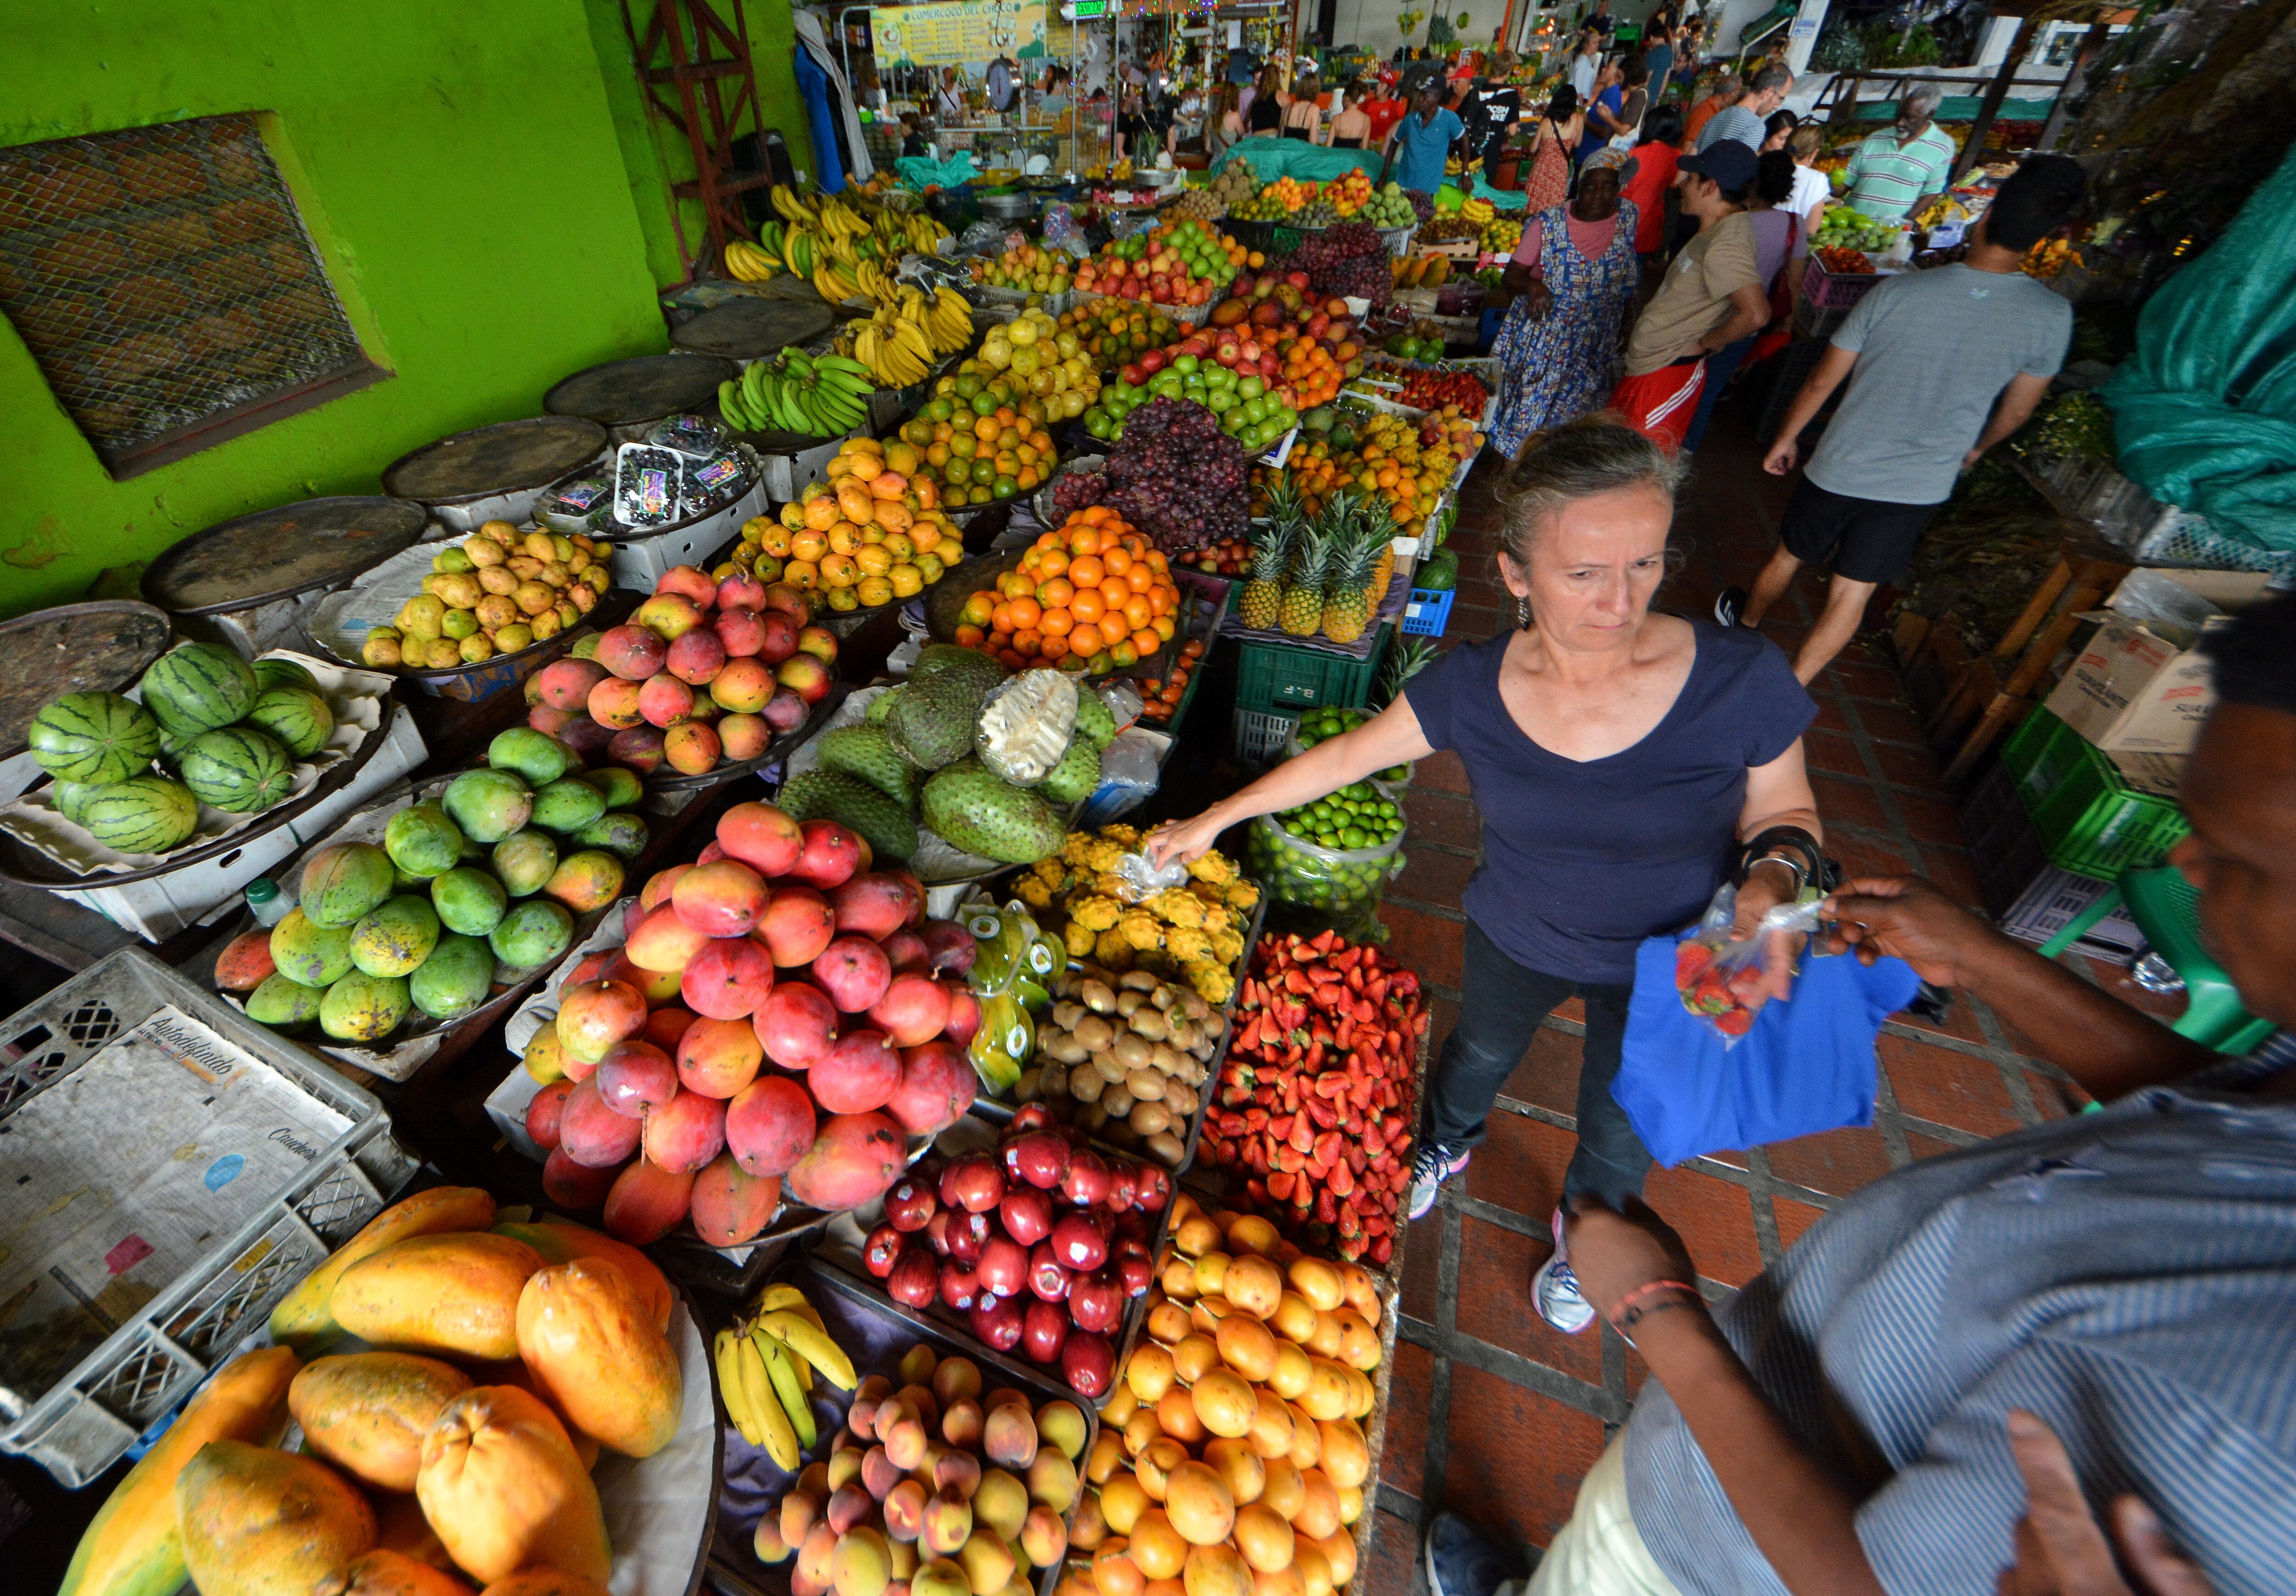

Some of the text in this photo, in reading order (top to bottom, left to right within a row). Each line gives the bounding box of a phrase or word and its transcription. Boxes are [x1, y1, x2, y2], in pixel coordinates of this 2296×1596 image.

[912, 6, 962, 20] COMERCOCO
[965, 5, 979, 16] DEL
[147, 1017, 236, 1074] Autodefinido
